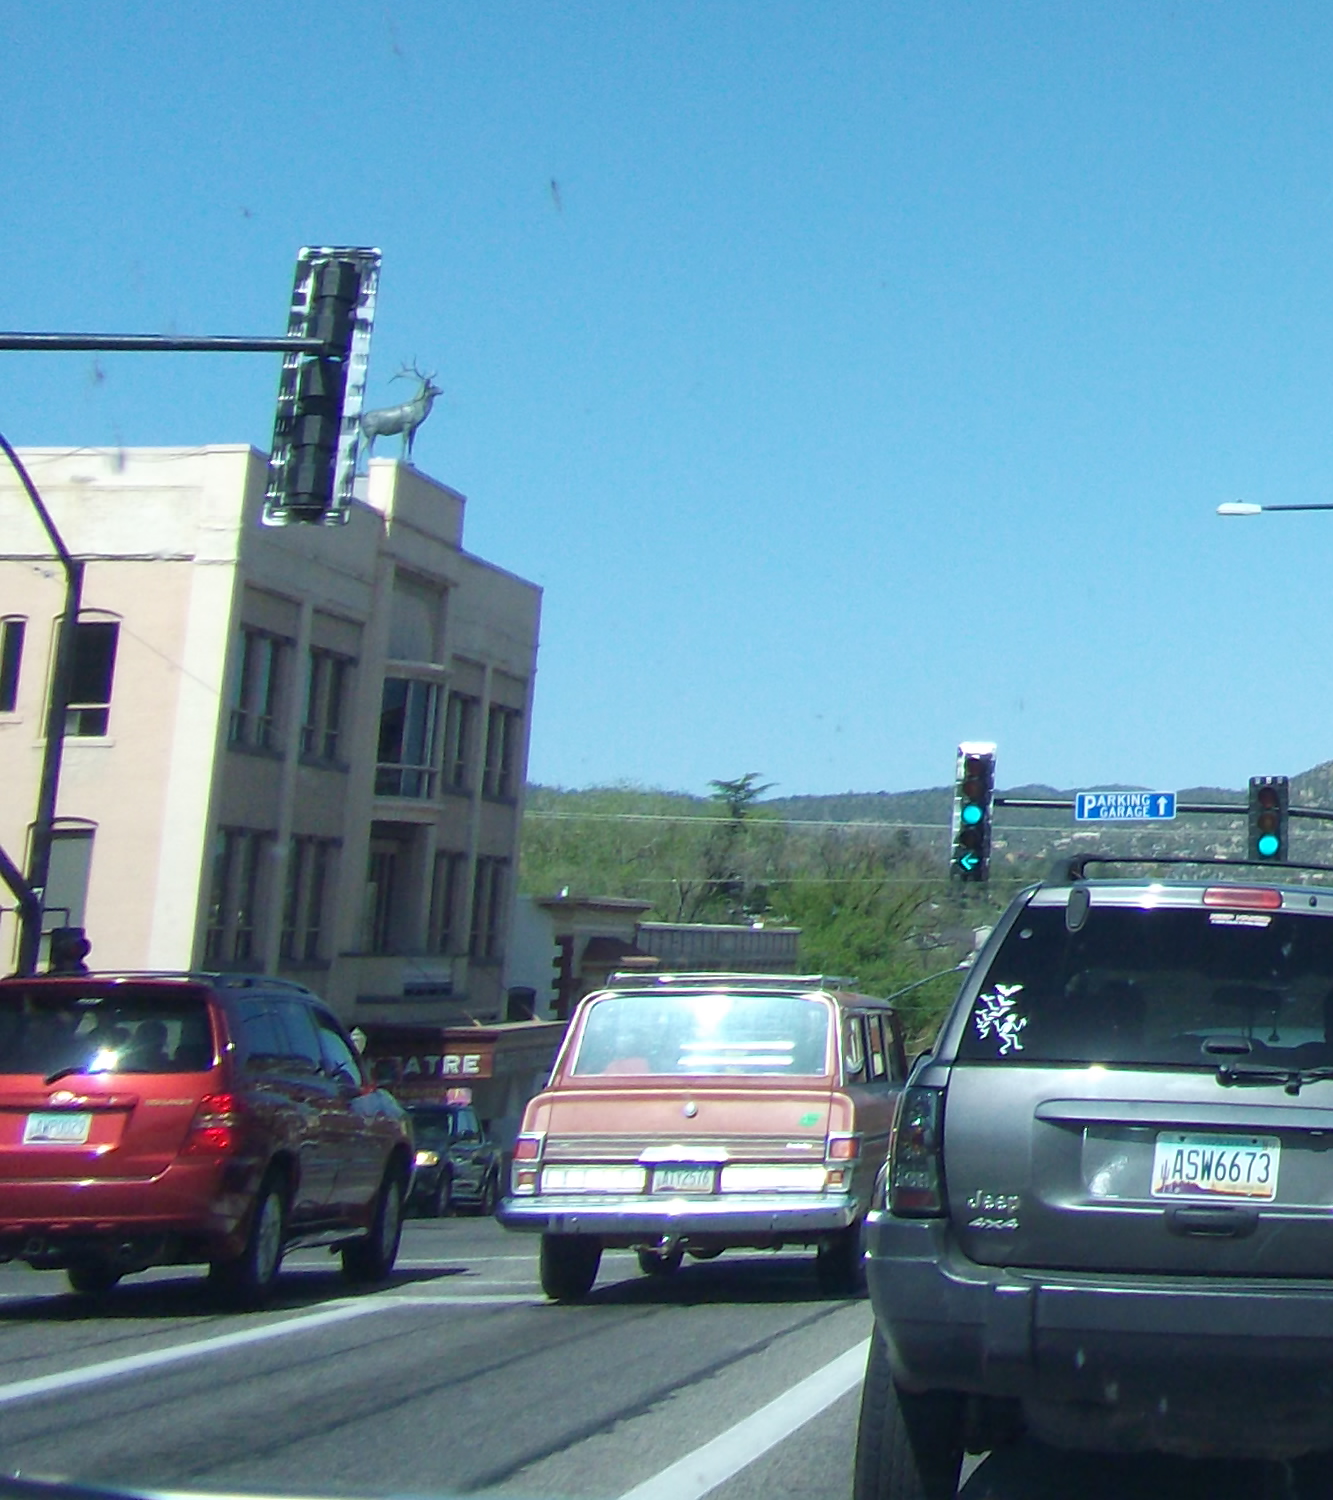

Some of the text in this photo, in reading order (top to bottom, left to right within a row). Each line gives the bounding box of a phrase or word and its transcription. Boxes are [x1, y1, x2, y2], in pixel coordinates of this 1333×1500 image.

[1083, 794, 1151, 819] PARKING
[1100, 806, 1150, 818] GARAGE
[1172, 1149, 1271, 1183] ASW6673
[967, 1189, 1020, 1213] Jeep
